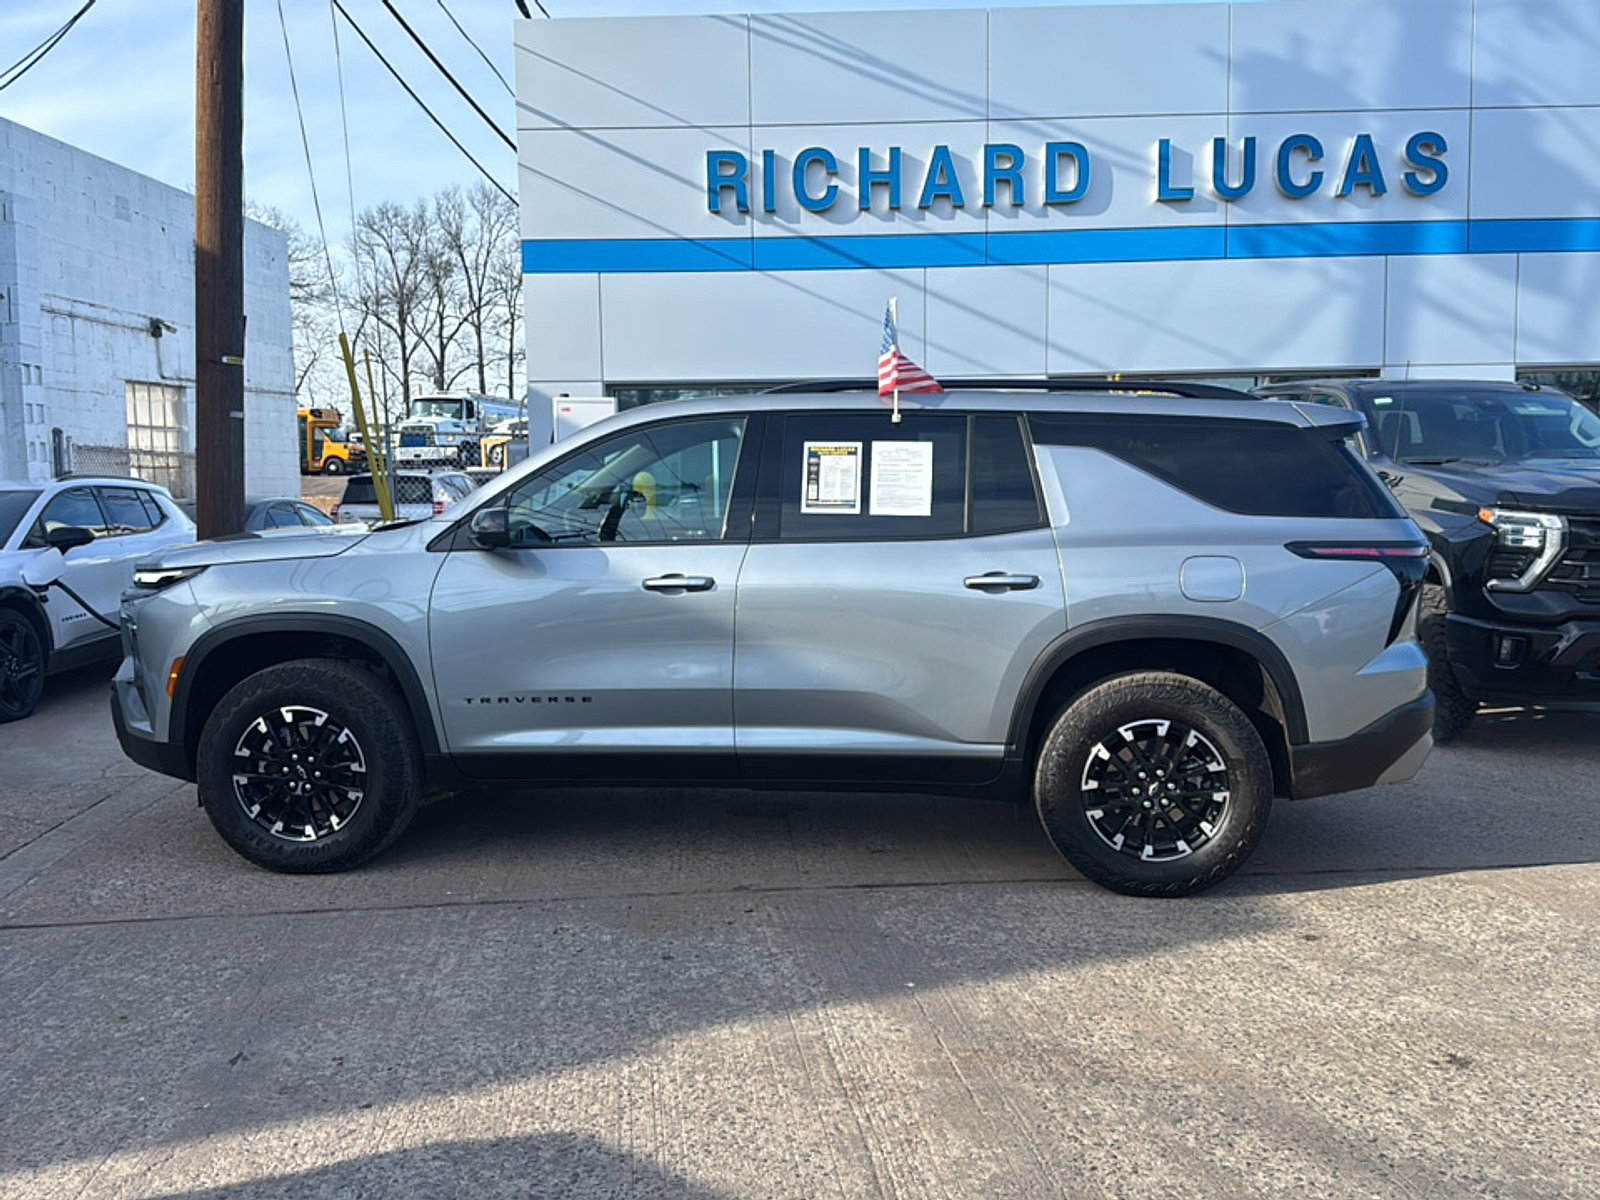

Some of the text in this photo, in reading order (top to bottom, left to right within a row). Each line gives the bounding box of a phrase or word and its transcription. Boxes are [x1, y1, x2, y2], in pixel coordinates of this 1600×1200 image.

[706, 131, 1449, 214] RICHARD LUCAS
[464, 696, 593, 705] TRAVERSE
